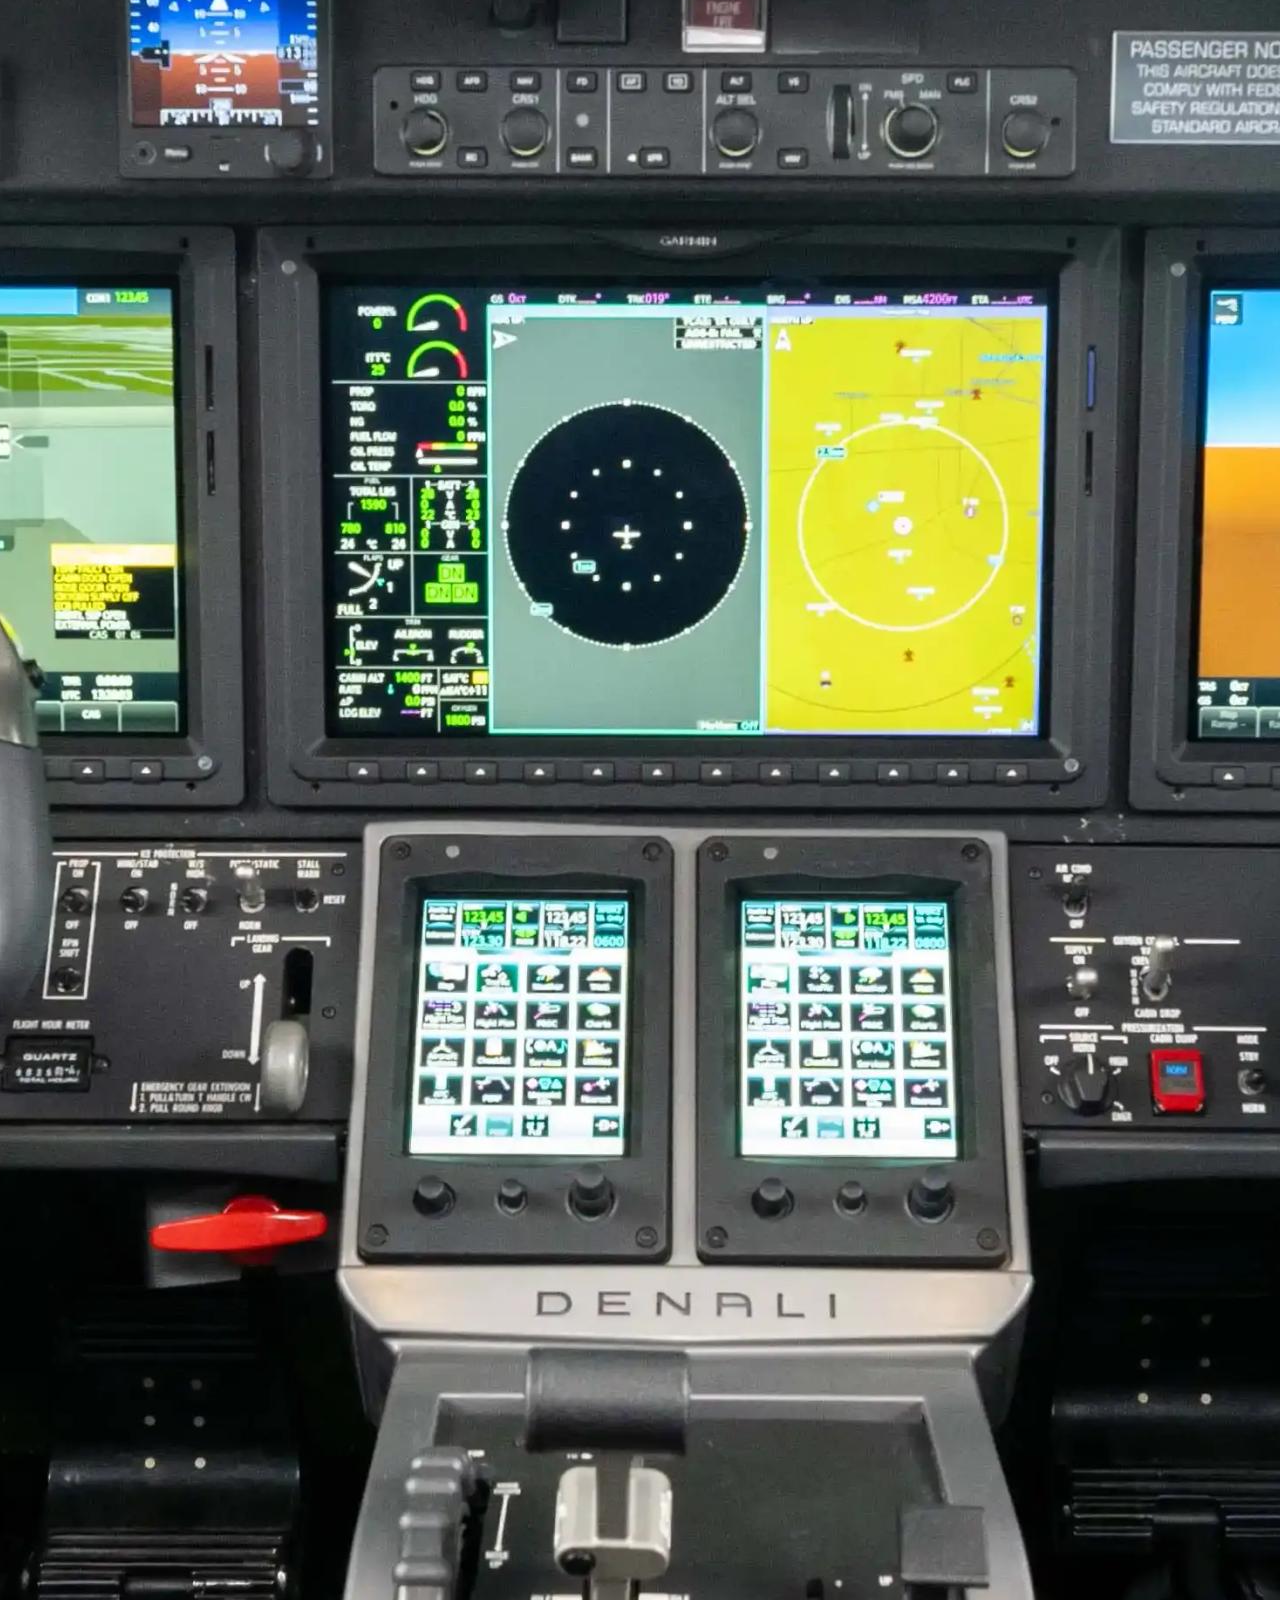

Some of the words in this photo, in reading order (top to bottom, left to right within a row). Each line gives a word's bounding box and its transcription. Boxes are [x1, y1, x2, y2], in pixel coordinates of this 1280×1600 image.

[1131, 41, 1248, 59] PASSENGER
[1137, 64, 1169, 78] THIS
[1174, 64, 1242, 78] AIRCRAFT
[901, 73, 924, 84] SPD
[919, 90, 941, 99] MAN
[1143, 83, 1202, 98] COMPLY
[1206, 83, 1243, 97] WITH
[414, 94, 437, 104] HDG
[716, 96, 735, 104] ALT
[1131, 101, 1186, 115] SAFETY
[1152, 120, 1230, 134] STANDARD
[660, 236, 717, 246] GARMIN
[373, 317, 382, 329] 0
[388, 559, 403, 570] UP
[442, 567, 462, 579] DN
[428, 586, 449, 598] DN
[453, 586, 474, 598] DN
[337, 604, 363, 615] FULL
[298, 860, 319, 868] STALL
[66, 921, 80, 929] OFF
[124, 921, 138, 929] OFF
[184, 922, 198, 930] OFF
[252, 944, 272, 952] GEAR
[222, 1050, 245, 1058] DOWN
[1045, 1056, 1059, 1065] OFF
[141, 1083, 184, 1091] EMERGENCY
[188, 1083, 207, 1091] GEAR
[211, 1083, 251, 1091] EXTENSION
[150, 1104, 168, 1112] PULL
[536, 1291, 838, 1319] DENALI
